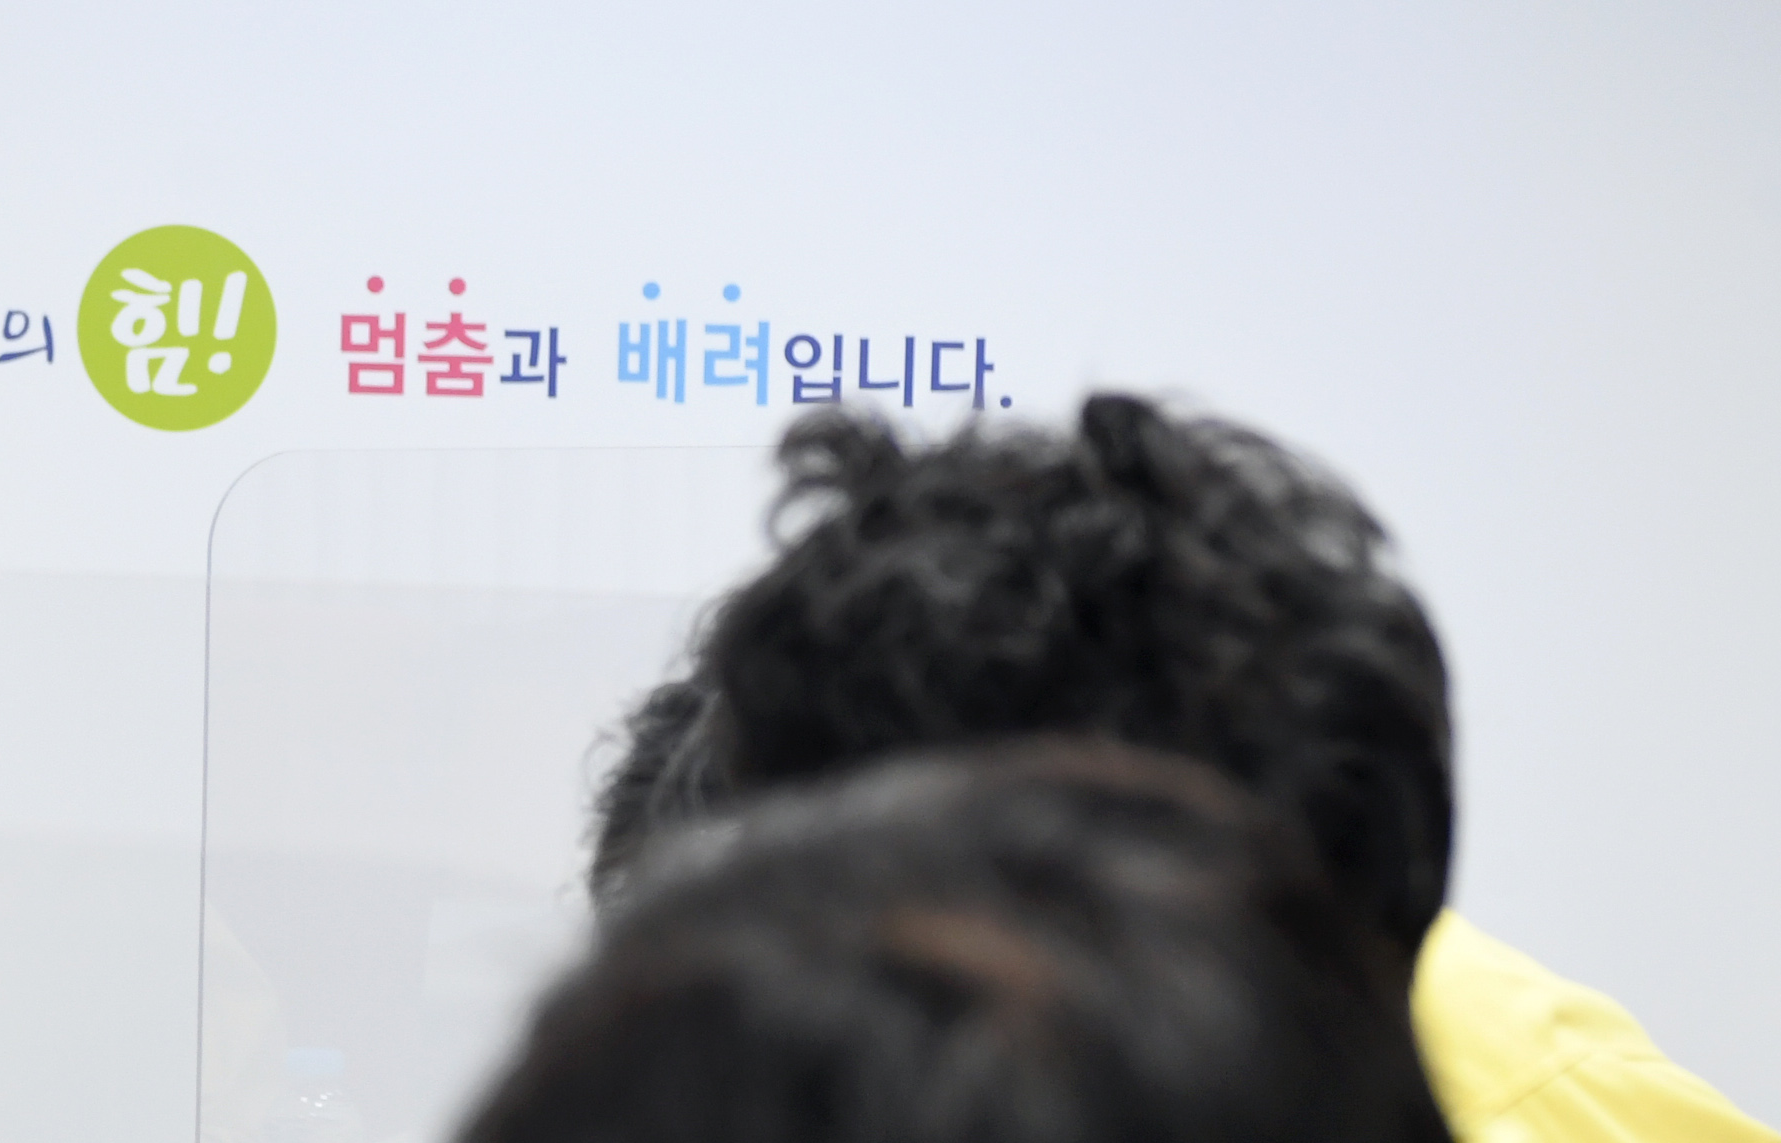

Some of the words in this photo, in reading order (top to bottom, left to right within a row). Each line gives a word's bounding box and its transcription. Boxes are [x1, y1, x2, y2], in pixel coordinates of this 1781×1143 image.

[110, 267, 248, 396] 힘!
[339, 310, 568, 399] 멈춤과
[616, 317, 1013, 411] 배려입니다.
